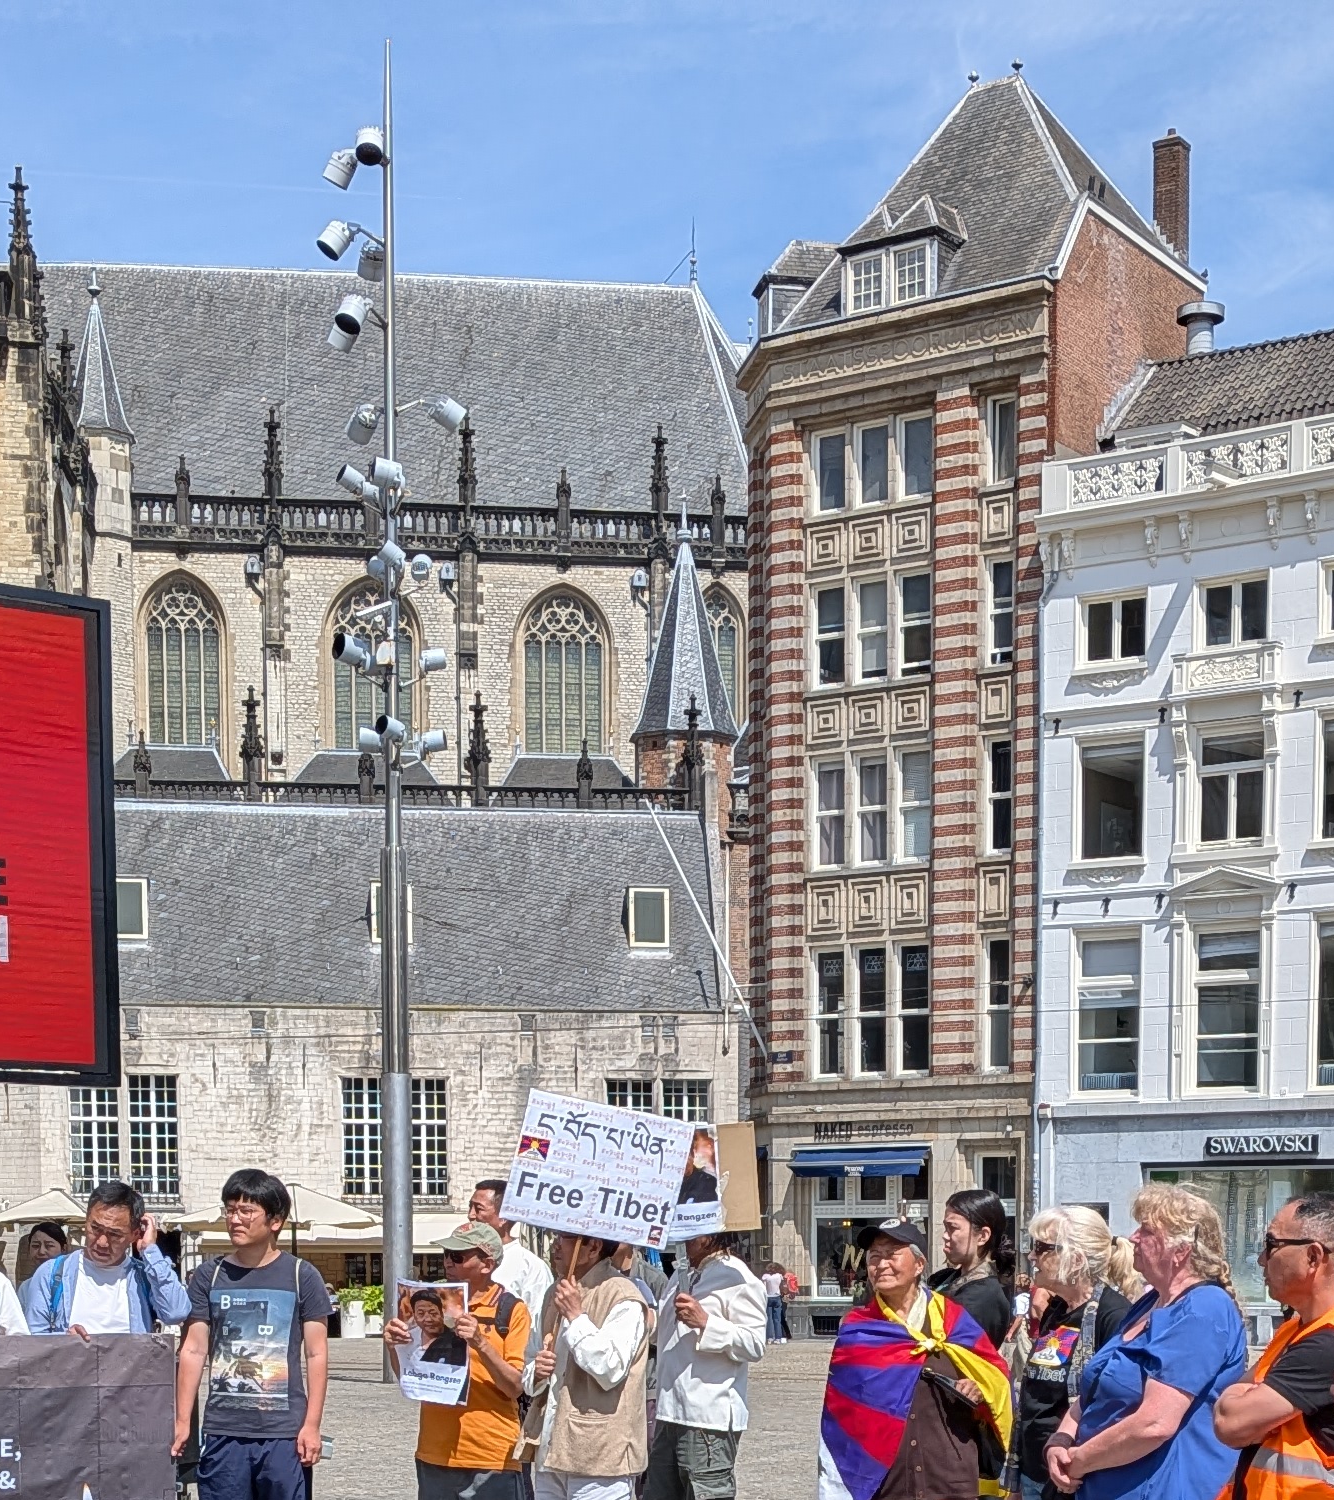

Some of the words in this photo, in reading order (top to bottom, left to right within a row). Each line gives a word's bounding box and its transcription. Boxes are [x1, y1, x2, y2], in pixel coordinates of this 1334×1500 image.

[1209, 1134, 1313, 1154] SWAROVSKI
[515, 1170, 585, 1209] Free
[597, 1186, 672, 1227] Tibet
[677, 1211, 718, 1223] Rangzen
[220, 1294, 232, 1311] B
